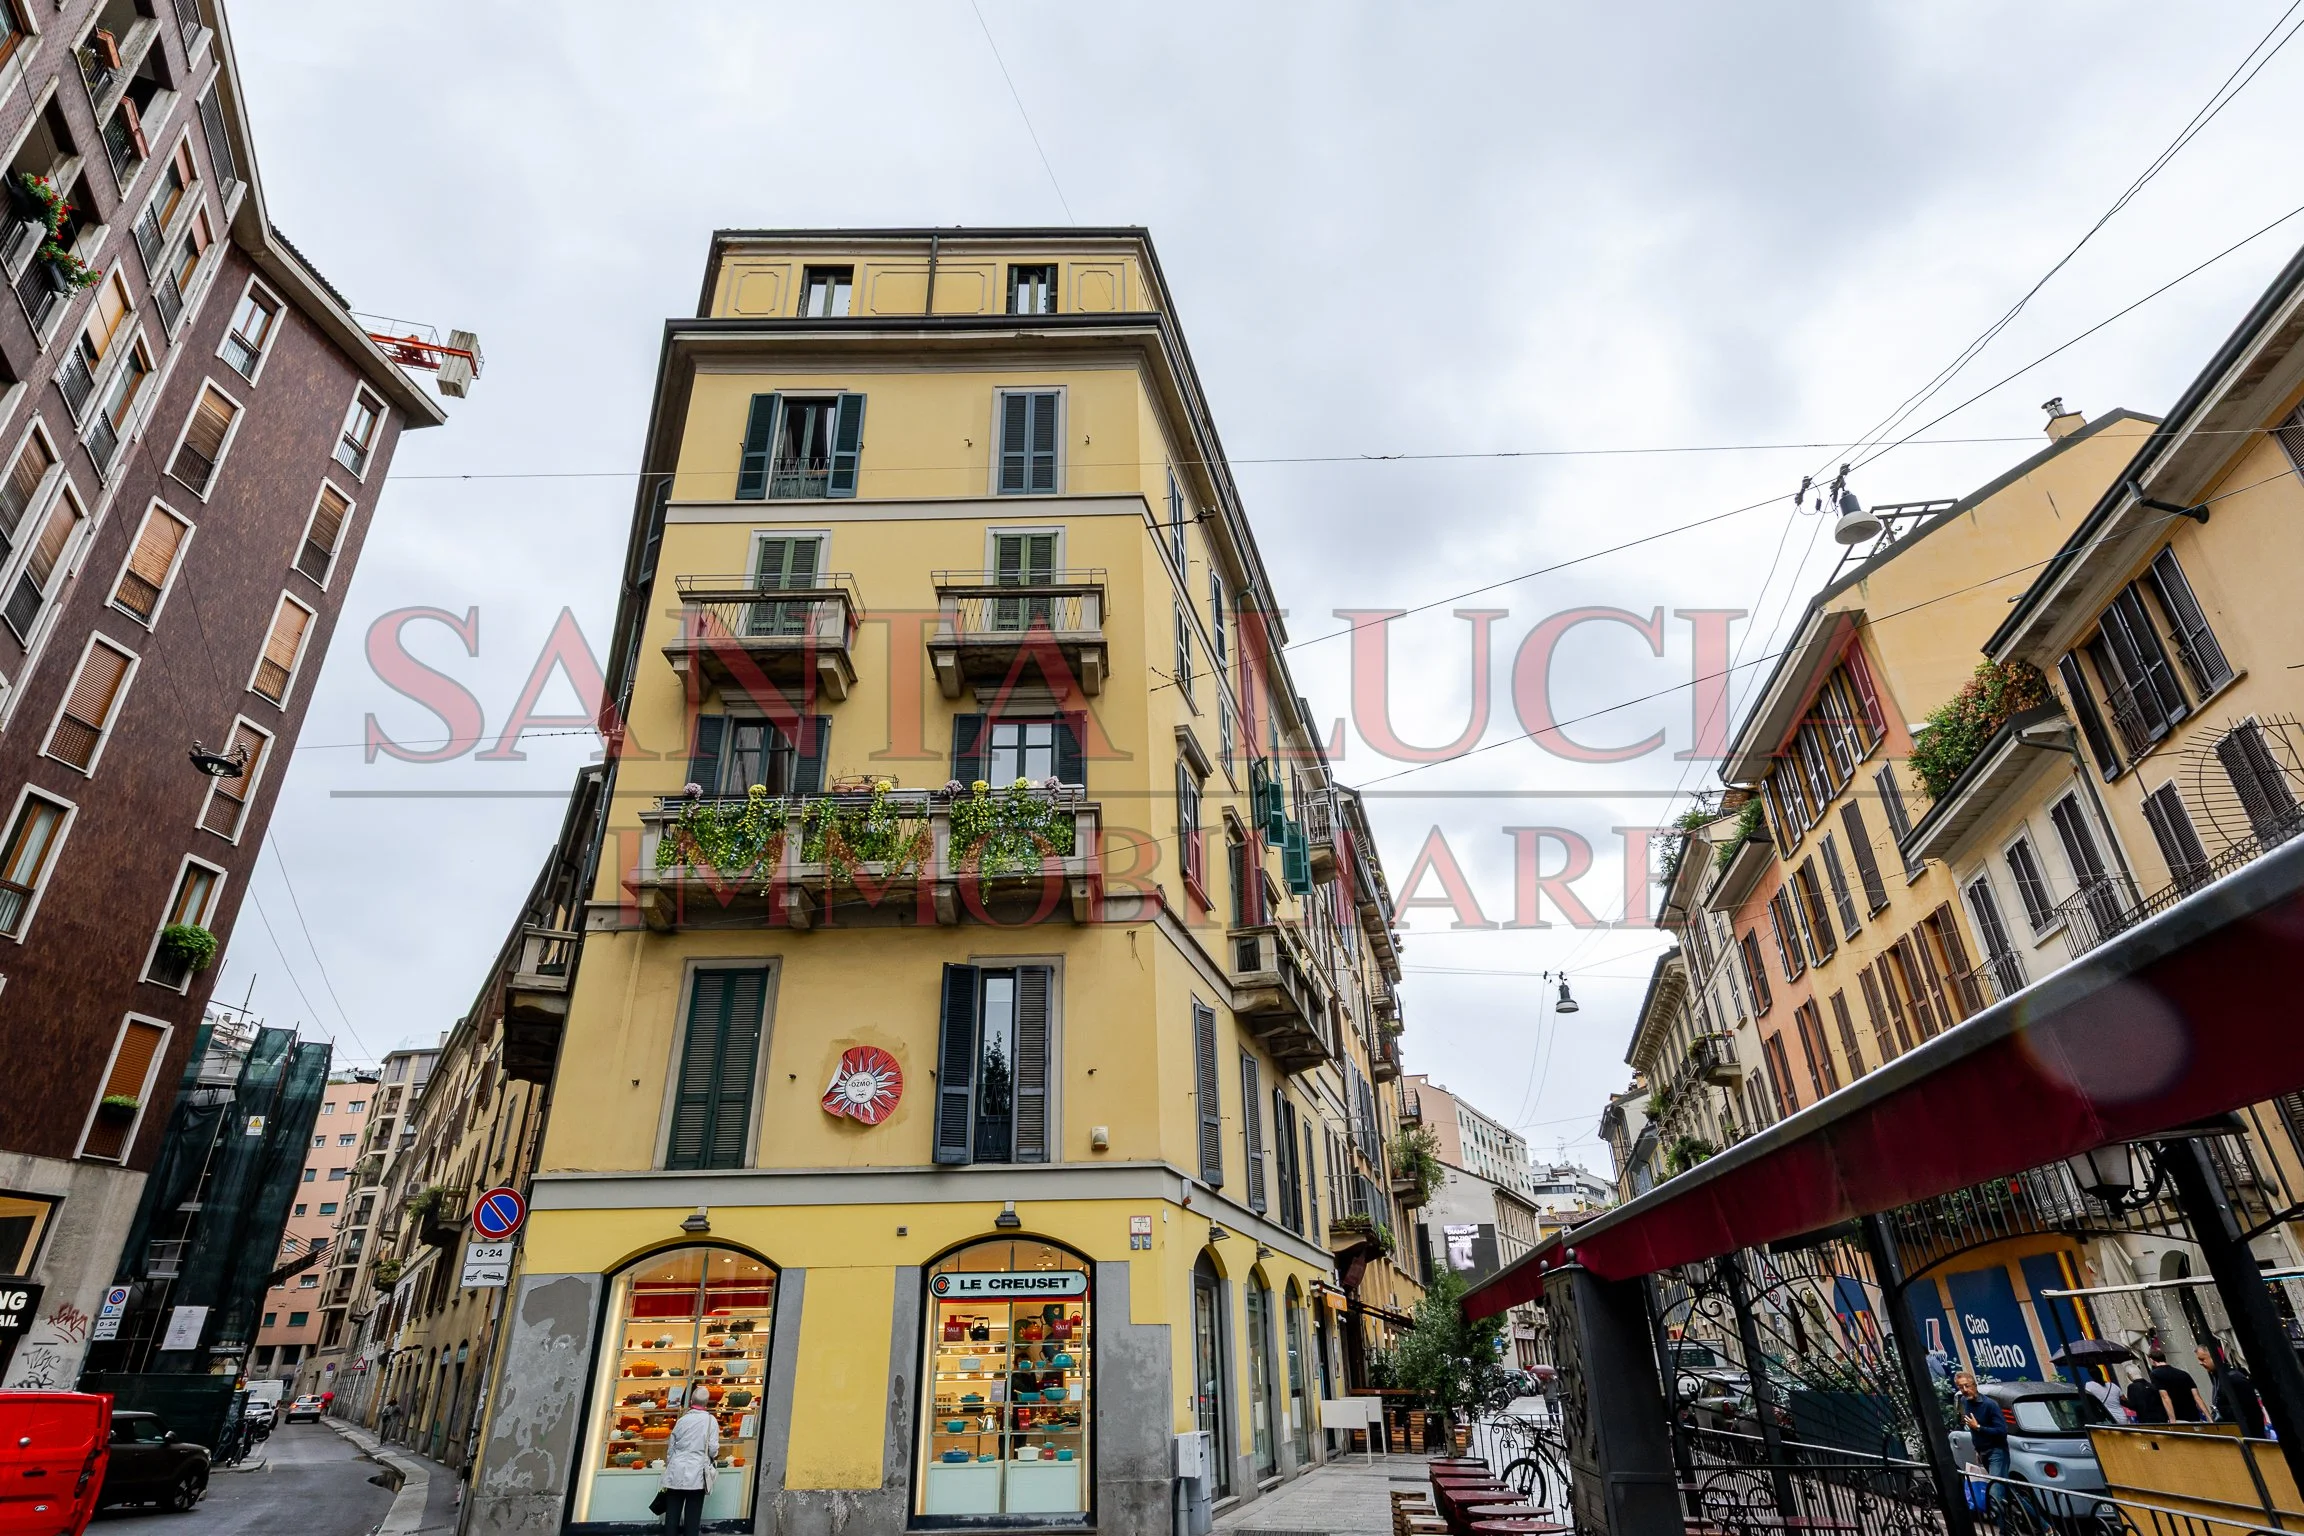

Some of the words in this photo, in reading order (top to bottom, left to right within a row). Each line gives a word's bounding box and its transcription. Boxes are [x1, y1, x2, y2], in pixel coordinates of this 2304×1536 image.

[476, 1249, 503, 1258] 0-24
[960, 1279, 982, 1290] LE
[988, 1277, 1070, 1290] CREUSET
[1965, 1314, 1990, 1335] Ciao
[1972, 1338, 2026, 1368] Milano
